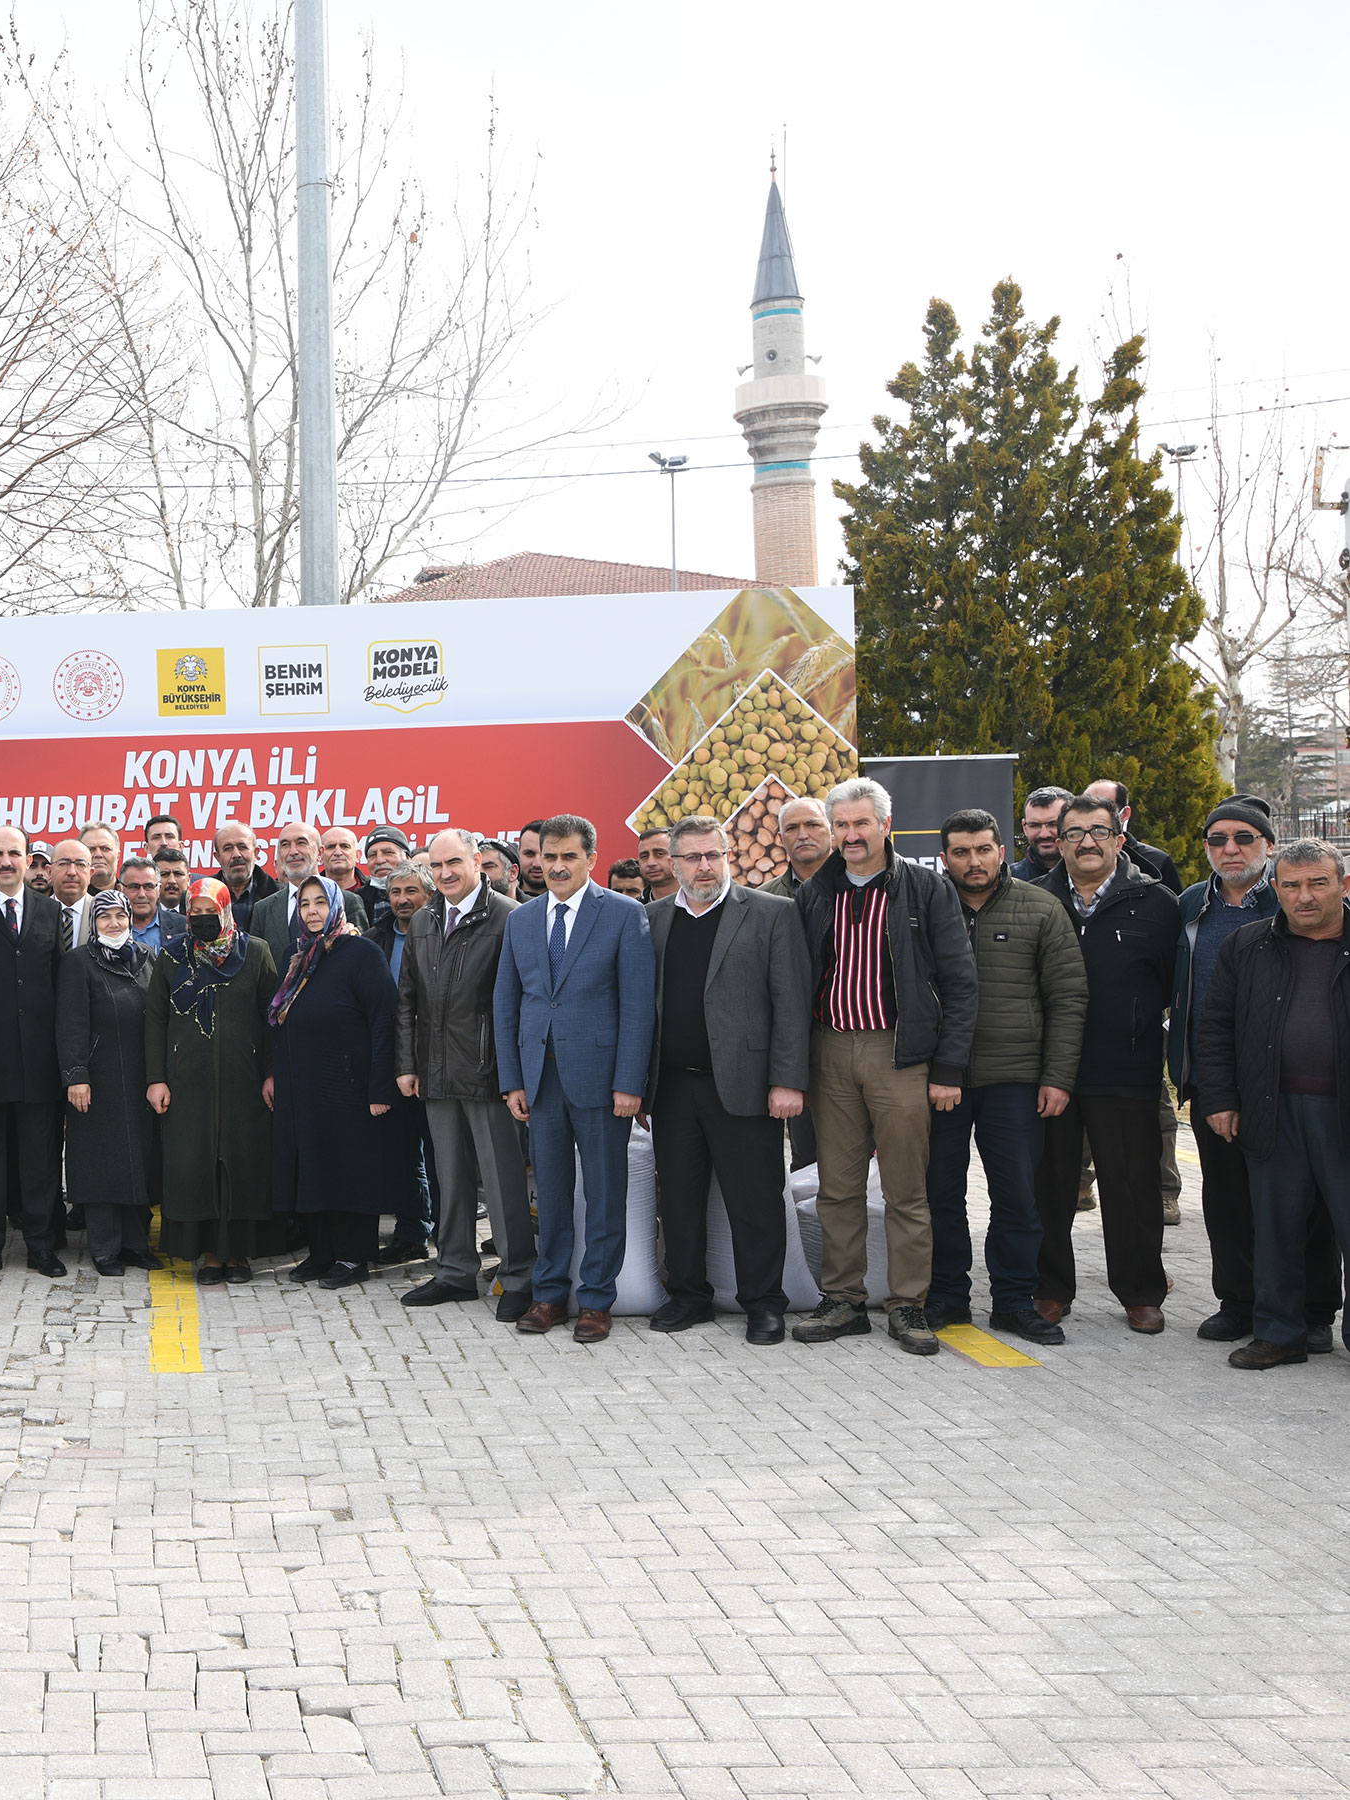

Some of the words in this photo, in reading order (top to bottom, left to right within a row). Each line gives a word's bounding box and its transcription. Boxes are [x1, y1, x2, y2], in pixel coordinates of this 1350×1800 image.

[374, 645, 438, 665] KONYA
[162, 692, 221, 704] BÜYÜKŞEHİR
[177, 684, 206, 693] KONYA
[363, 676, 449, 703] Belediyecilik
[123, 748, 257, 788] KONYA
[189, 791, 242, 830] VE
